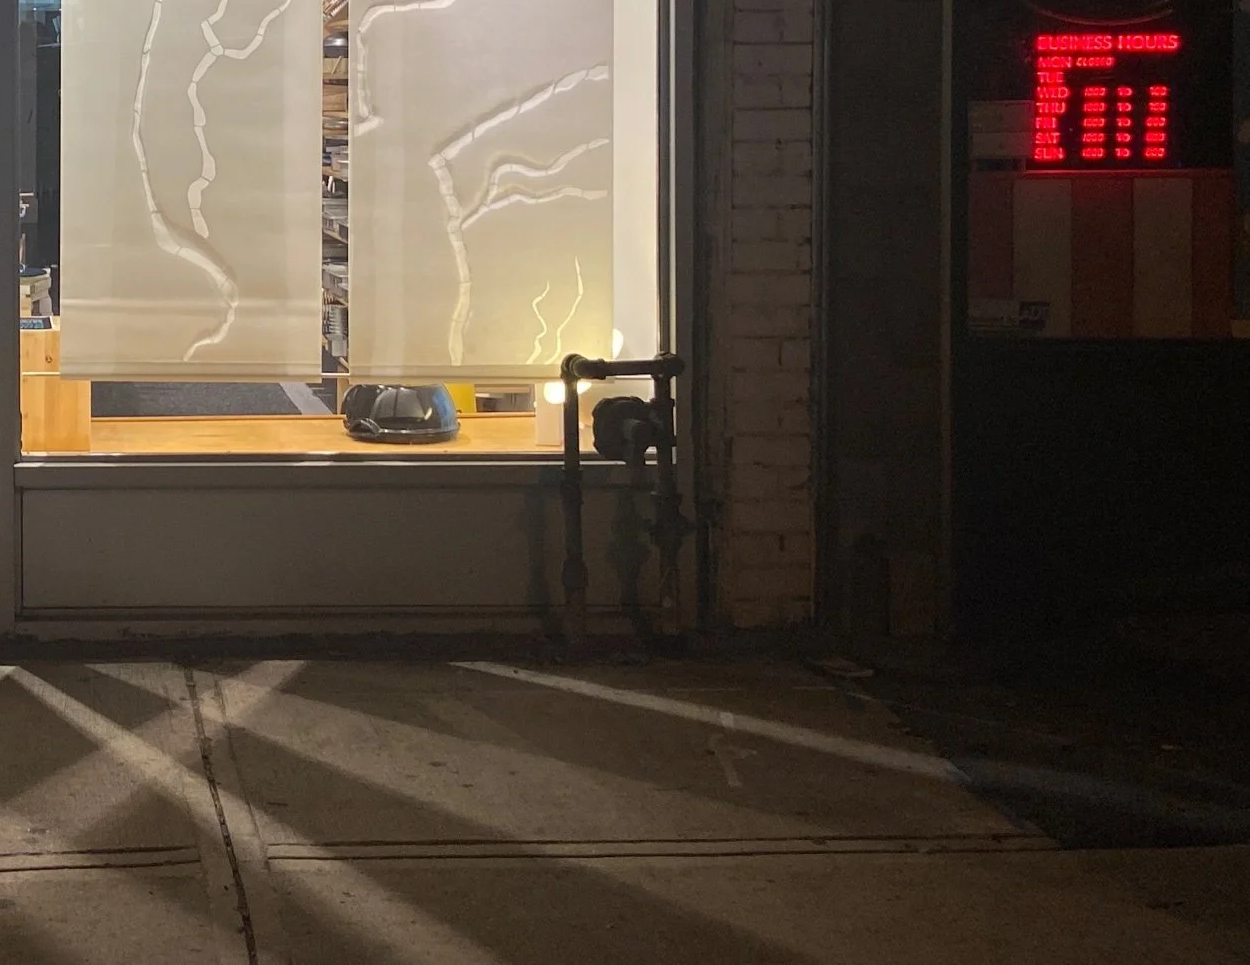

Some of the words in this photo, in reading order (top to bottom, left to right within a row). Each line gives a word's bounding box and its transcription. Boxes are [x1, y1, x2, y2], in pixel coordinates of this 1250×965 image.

[1037, 35, 1113, 51] BUSINESS
[1116, 35, 1180, 50] HOURS
[1037, 56, 1072, 68] MON
[1036, 71, 1065, 83] TUE
[1037, 87, 1069, 98] WED
[1036, 102, 1066, 114] THU
[1035, 117, 1058, 129] FRI
[1035, 132, 1061, 144] SAT
[1035, 148, 1064, 159] SUN
